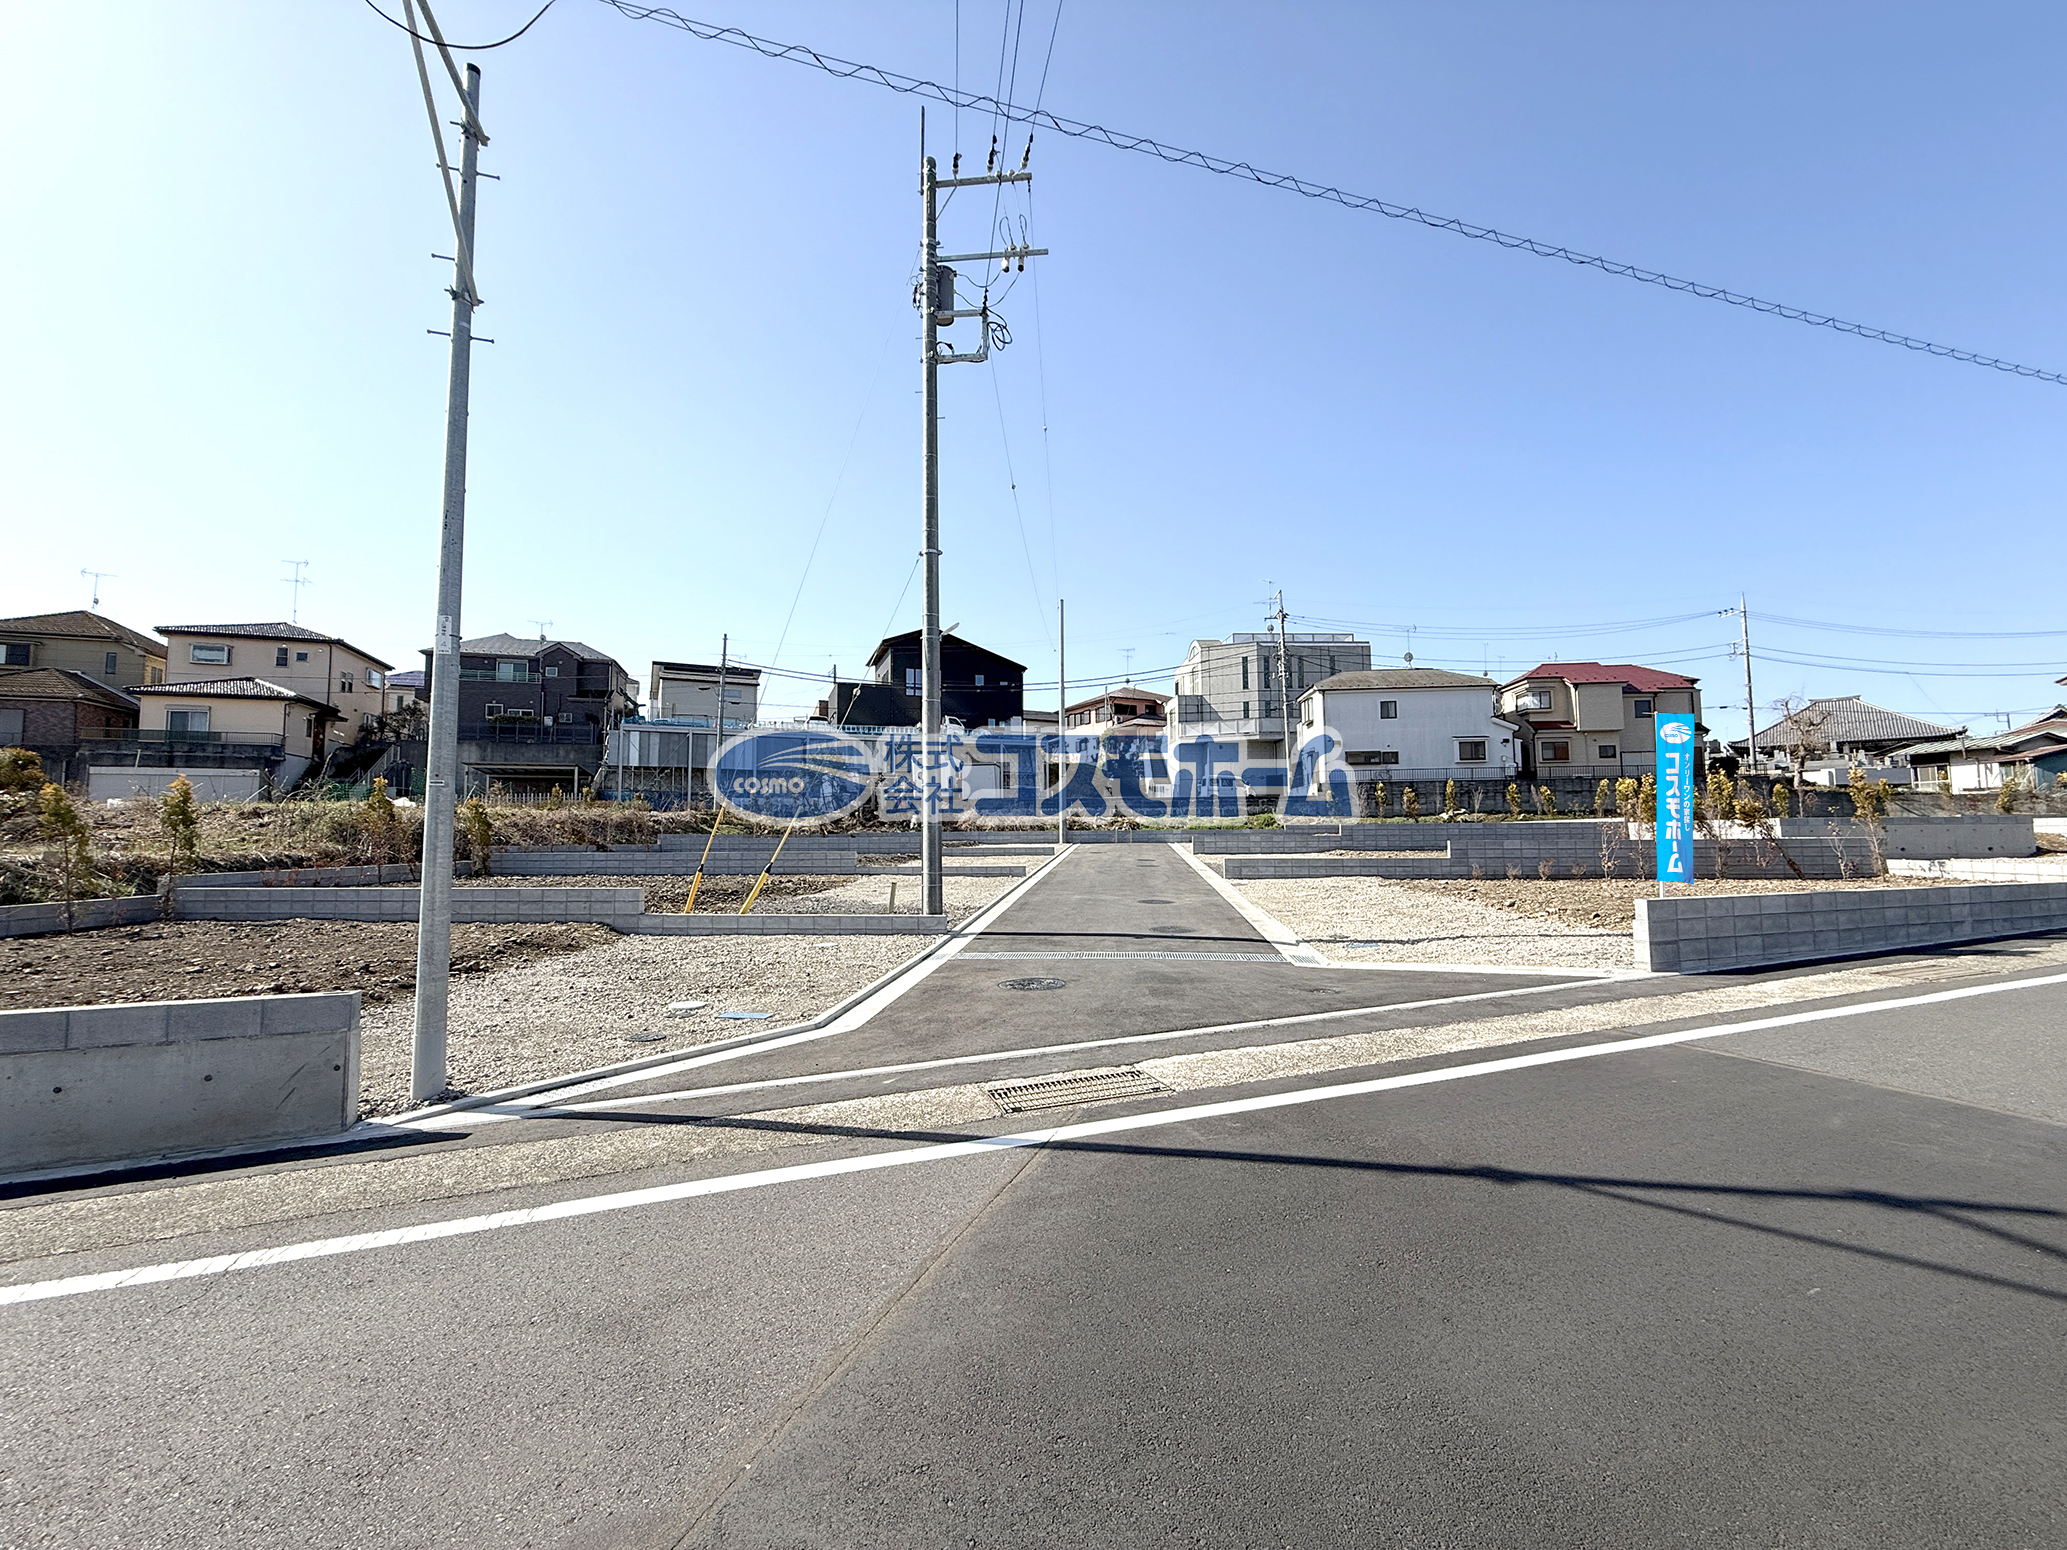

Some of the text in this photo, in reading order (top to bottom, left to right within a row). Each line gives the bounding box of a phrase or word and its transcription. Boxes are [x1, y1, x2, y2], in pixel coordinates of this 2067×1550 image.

[1665, 752, 1683, 873] コスモホーム
